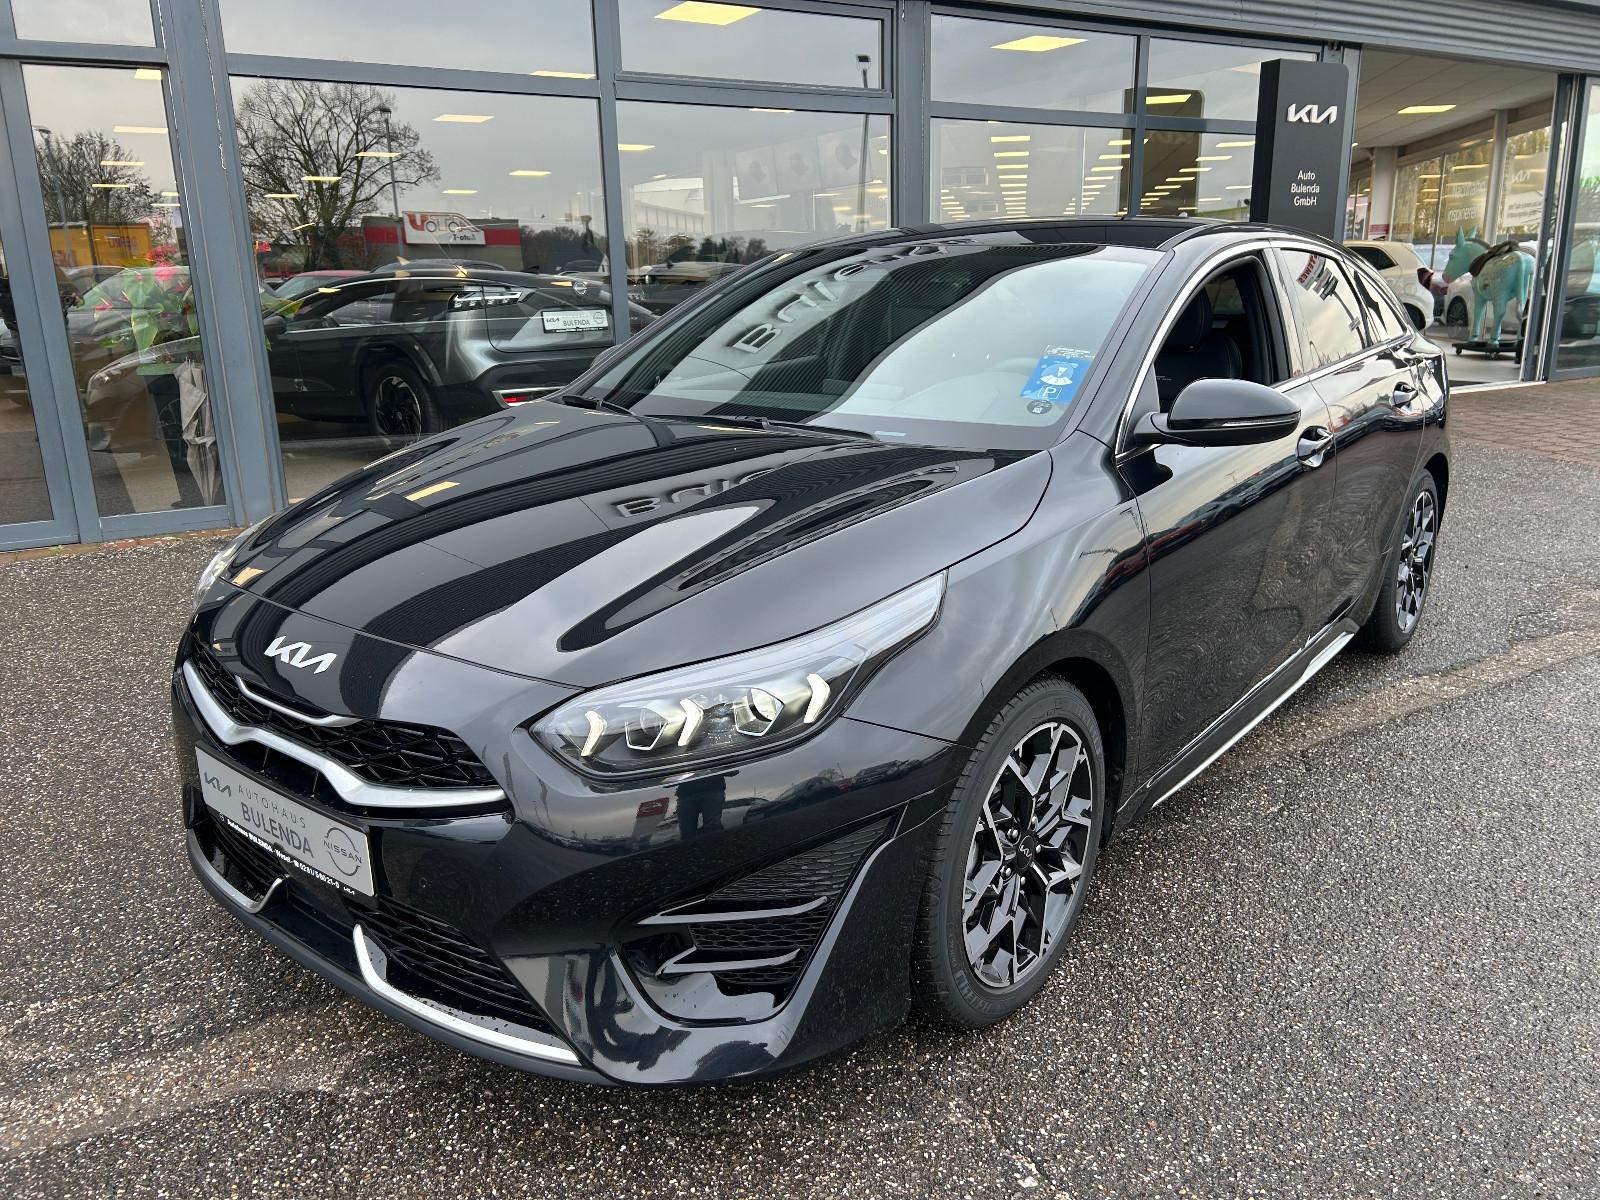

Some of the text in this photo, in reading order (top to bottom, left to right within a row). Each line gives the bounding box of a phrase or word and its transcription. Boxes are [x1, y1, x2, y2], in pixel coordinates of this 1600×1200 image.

[1287, 103, 1338, 124] KIA
[1297, 170, 1316, 180] Auto
[1290, 183, 1320, 193] Bulenda
[1293, 196, 1317, 206] GmbH
[264, 636, 338, 675] KIA
[204, 771, 232, 798] KIA
[238, 783, 307, 829] AUTOHAUS
[241, 802, 315, 859] BULENDA
[323, 840, 362, 864] NISSAN
